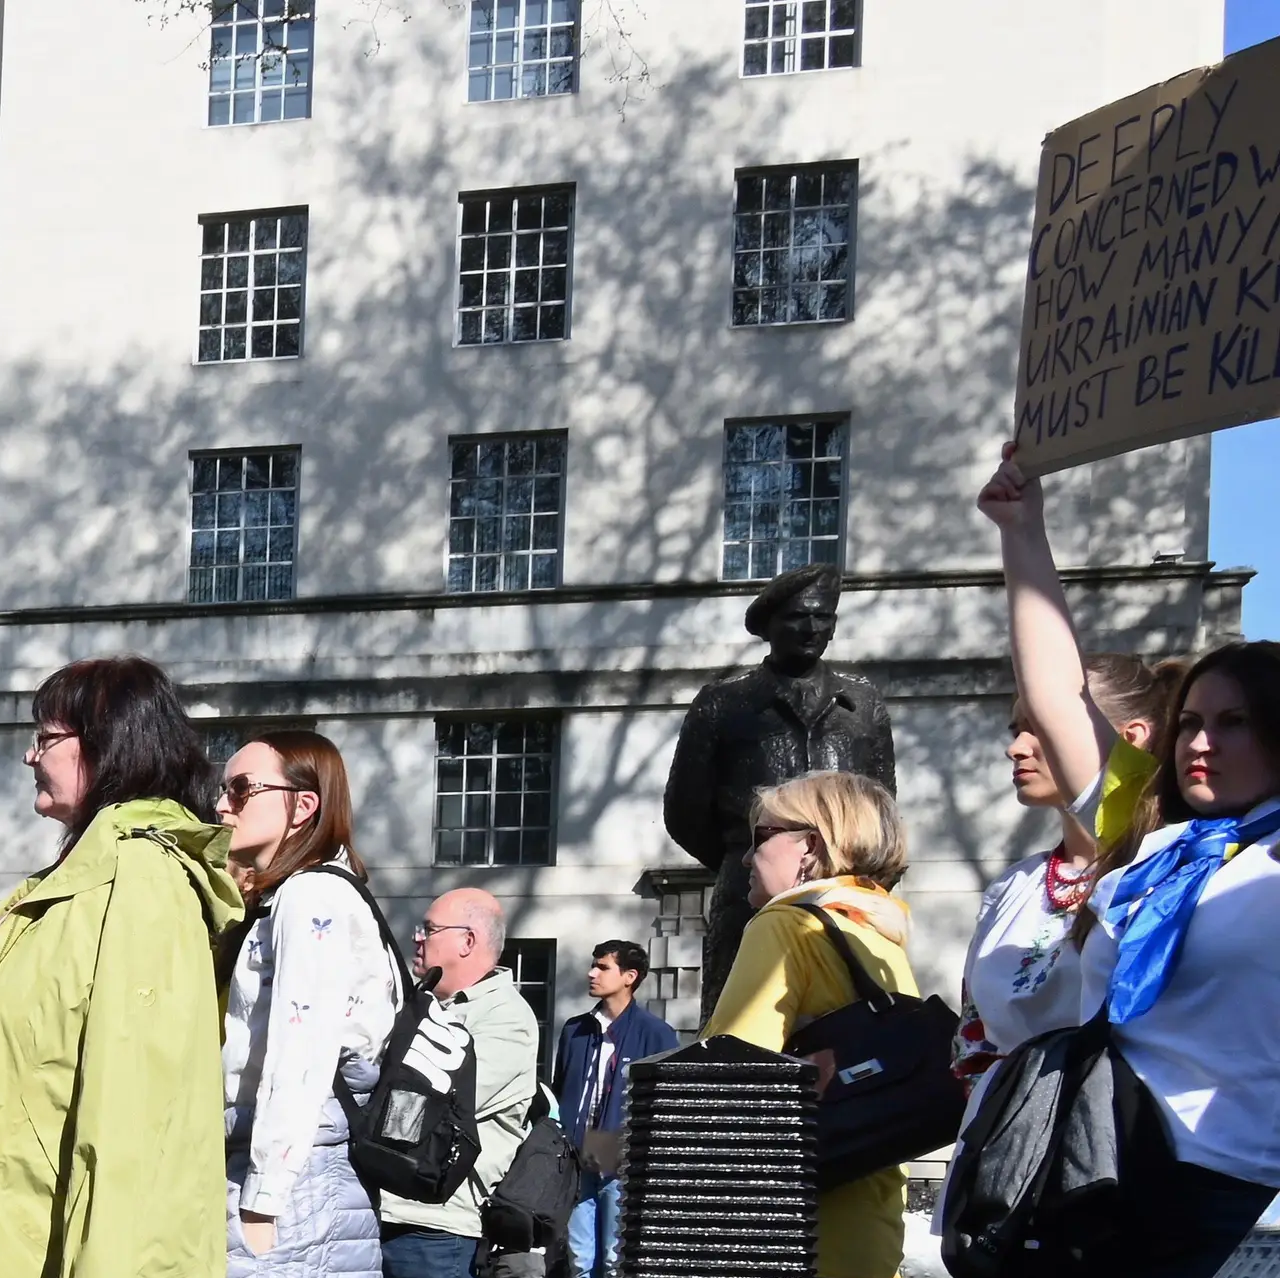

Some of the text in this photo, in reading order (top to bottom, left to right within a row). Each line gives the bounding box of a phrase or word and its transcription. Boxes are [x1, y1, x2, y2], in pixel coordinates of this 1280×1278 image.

[1049, 78, 1238, 217] DEEPLY
[1031, 151, 1238, 281] CONCERNED
[1033, 249, 1117, 329] HOW
[1134, 197, 1265, 287] MANY
[1016, 366, 1124, 446] MUST
[1135, 342, 1189, 406] BE
[1026, 276, 1218, 387] UKRAINIAN
